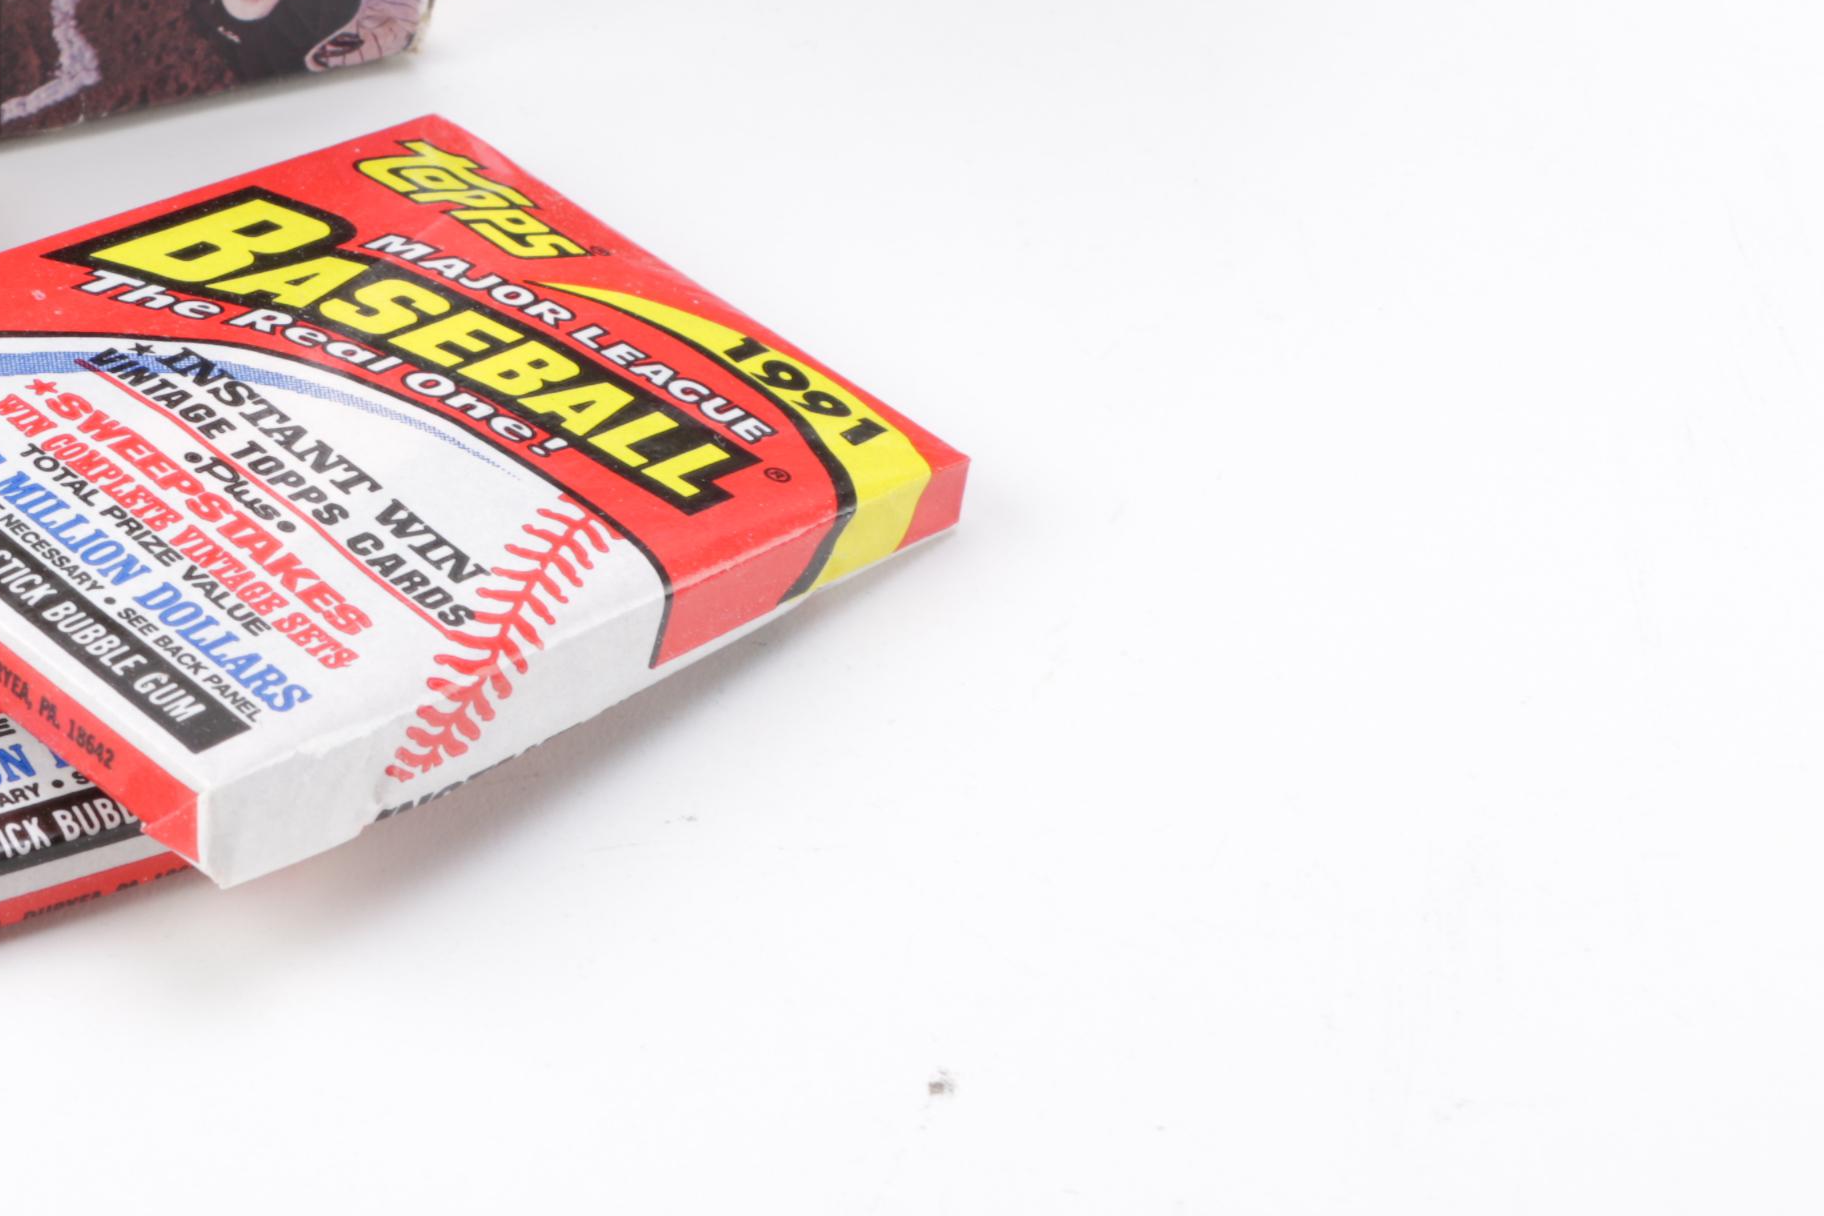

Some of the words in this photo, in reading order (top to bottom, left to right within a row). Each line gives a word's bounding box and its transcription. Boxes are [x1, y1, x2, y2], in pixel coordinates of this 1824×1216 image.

[80, 271, 226, 318] The
[243, 305, 399, 370] Real
[399, 370, 570, 460] One!
[90, 196, 736, 500] BASEBALL
[367, 233, 579, 325] MAJOR
[577, 323, 777, 443] LEAGUE
[727, 337, 886, 445] 1991
[21, 444, 100, 503] TOTAL
[100, 503, 181, 564] PRIZE
[182, 563, 271, 635] VALUE
[40, 432, 178, 533] COMPLETE
[169, 530, 282, 617] VINTAGE
[275, 614, 358, 669] SETS
[41, 393, 373, 642] SWEEPSTAKES
[88, 348, 229, 440] VINTAGE
[240, 442, 347, 524] TOPPS
[345, 532, 476, 627] CARDS
[155, 346, 379, 494] INSTANT
[374, 499, 490, 583] WIN
[5, 514, 105, 603] NECESSARY
[117, 607, 159, 641] SEE
[158, 634, 205, 675] BACK
[201, 669, 262, 723] PANEL
[47, 597, 141, 678] BUBBLE
[133, 665, 205, 724] GUM
[133, 582, 312, 713] DOLLARS
[65, 716, 115, 771] 18642
